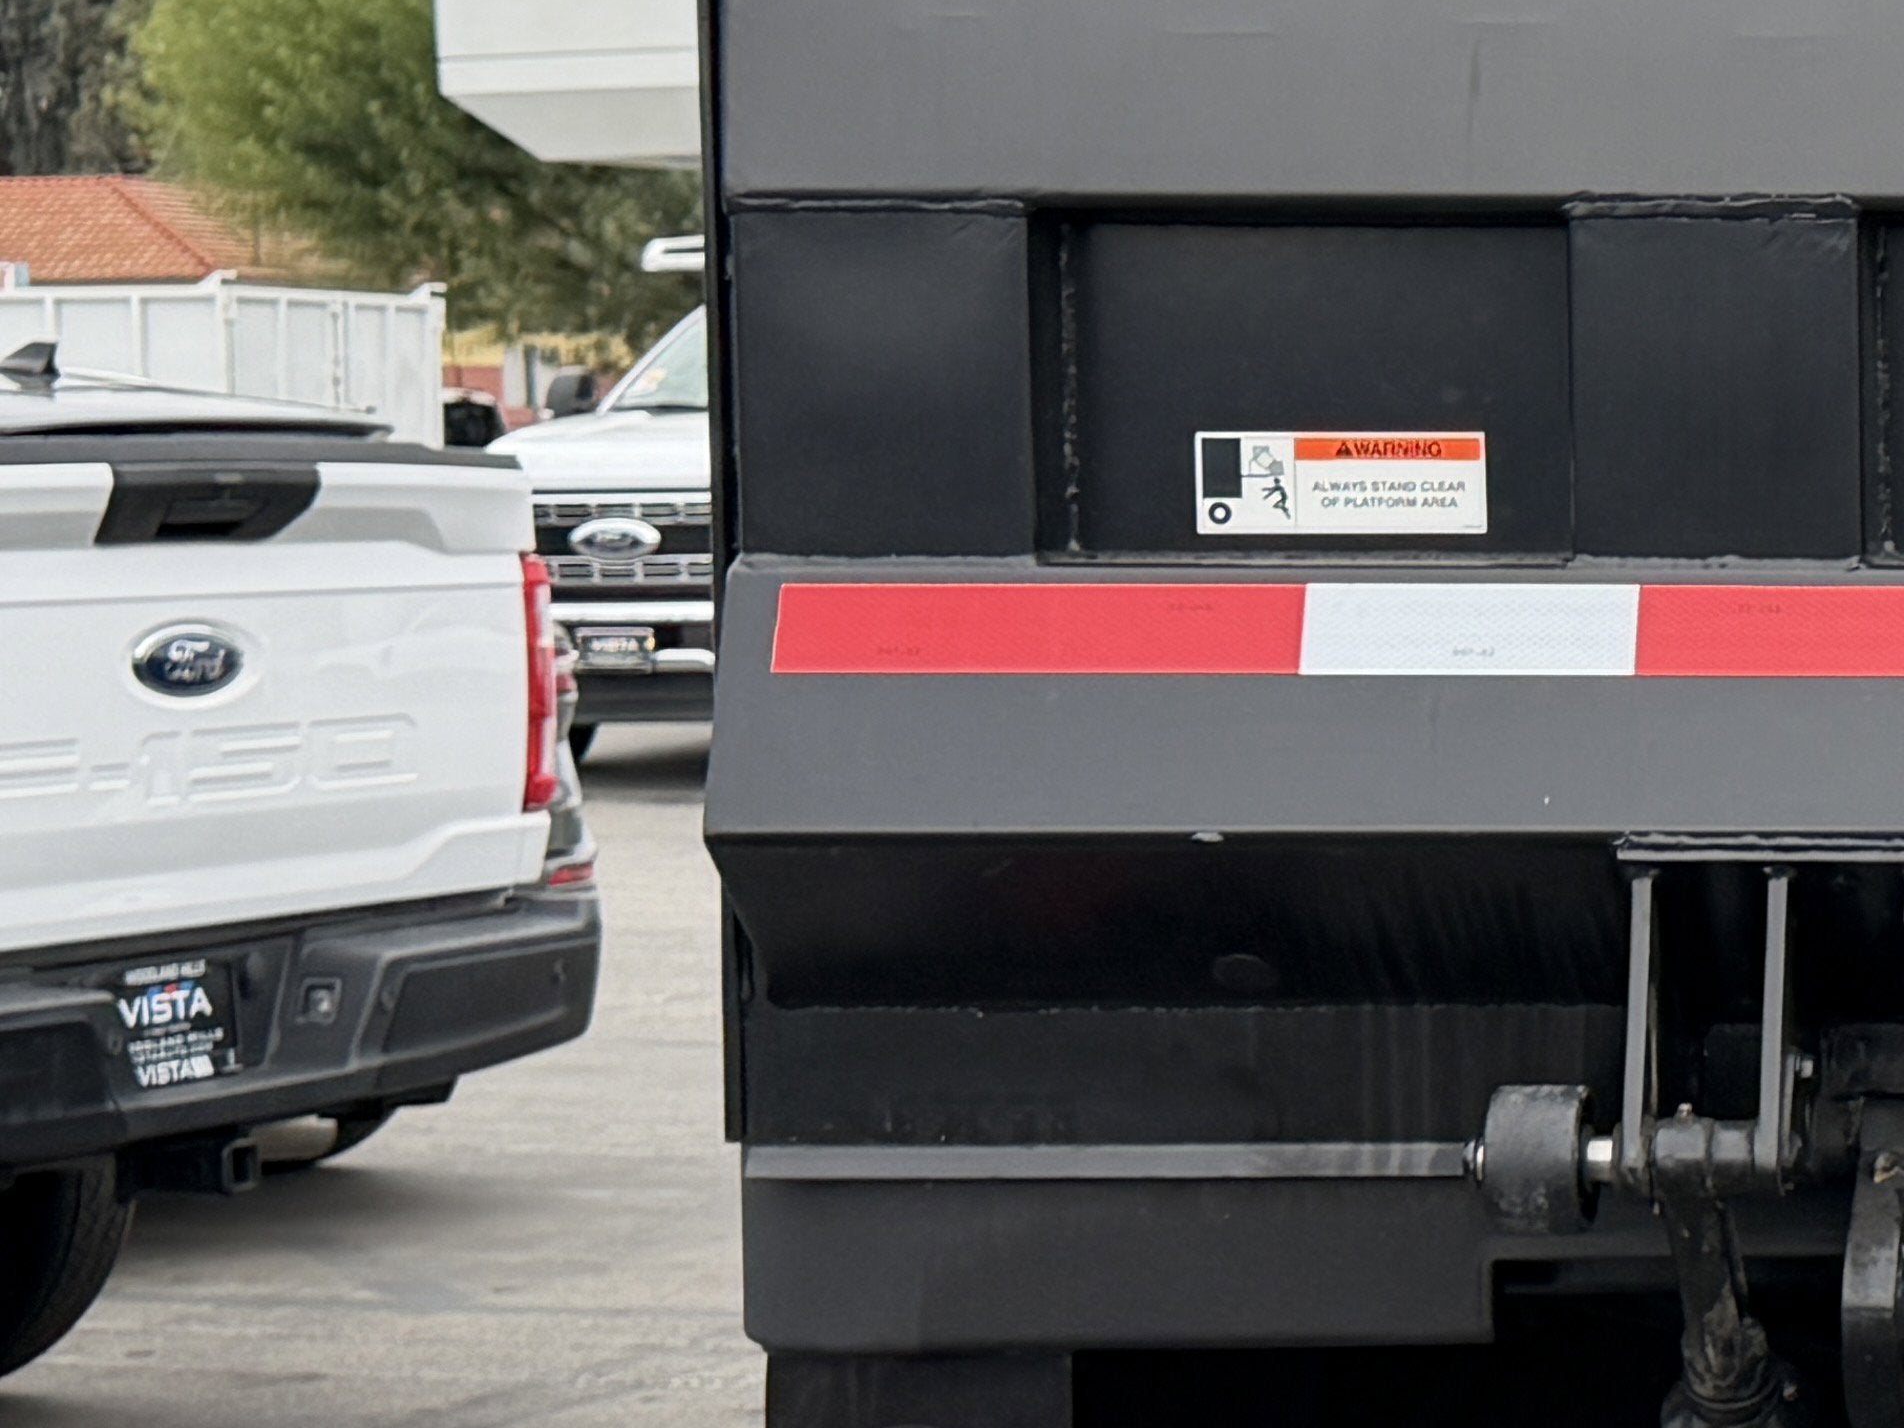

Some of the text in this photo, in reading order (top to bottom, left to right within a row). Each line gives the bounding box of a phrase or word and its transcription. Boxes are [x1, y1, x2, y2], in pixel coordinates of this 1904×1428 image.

[1354, 441, 1442, 457] WARNING
[1312, 481, 1466, 492] ALWAYS STAND CLEAR
[1320, 497, 1458, 508] OF PLATFORM AREA
[117, 986, 213, 1029] VISTA
[134, 1058, 195, 1088] VISTA
